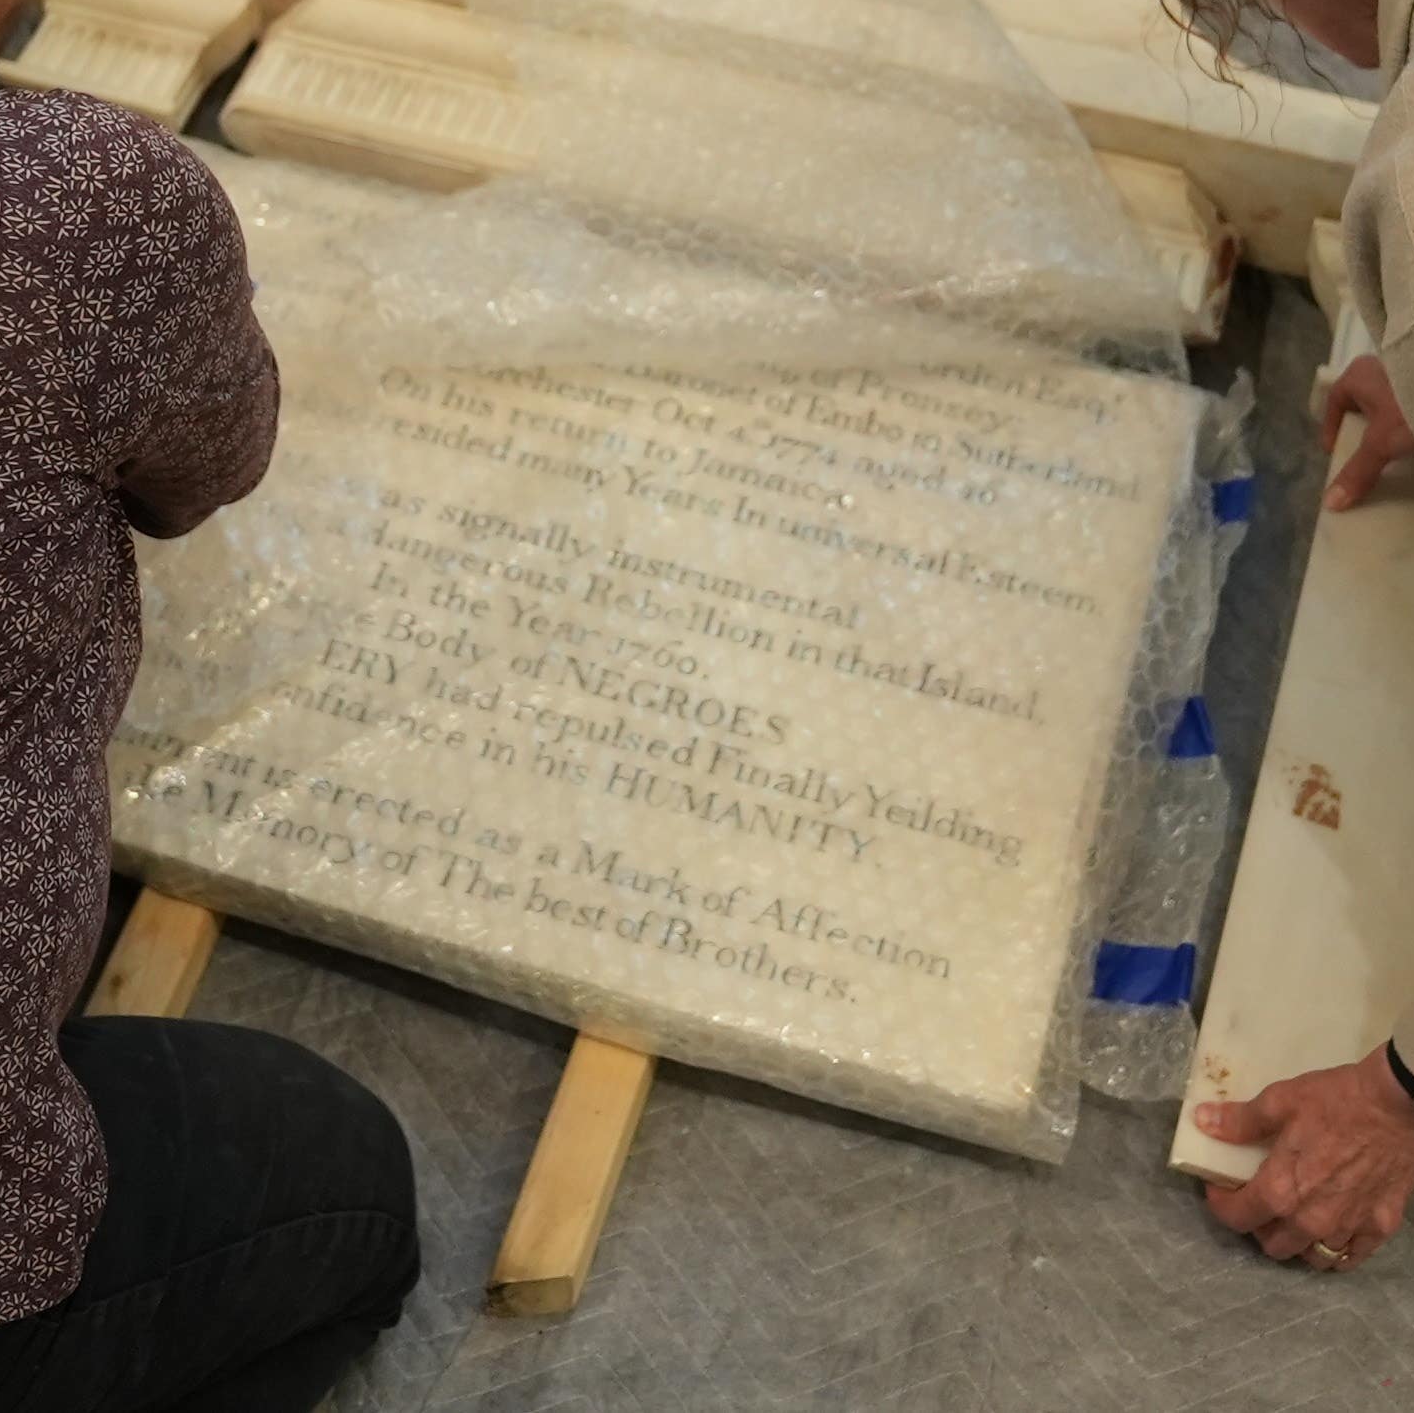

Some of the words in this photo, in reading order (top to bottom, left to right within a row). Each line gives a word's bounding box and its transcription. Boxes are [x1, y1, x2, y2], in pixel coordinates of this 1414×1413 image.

[380, 365, 431, 403] On
[440, 382, 495, 418] his
[508, 408, 635, 457] return
[642, 438, 678, 464] to
[438, 500, 596, 565] signally
[606, 536, 860, 630] instrumental
[515, 450, 617, 493] many
[623, 464, 724, 517] Years
[733, 494, 767, 528] In
[779, 515, 949, 575] universal
[371, 561, 409, 599] In
[430, 580, 491, 620] the
[508, 594, 602, 647] Year
[372, 518, 569, 596] dangerous
[581, 572, 774, 654] Rebellion
[786, 628, 823, 665] in
[834, 643, 910, 688] that
[385, 608, 497, 670] Body
[509, 652, 554, 681] of
[556, 655, 791, 747] NEGROES
[425, 665, 504, 713] had
[511, 701, 700, 767] repulsed
[707, 740, 856, 816] Finally
[865, 782, 1023, 869] Yeilding
[479, 725, 517, 767] in
[533, 740, 591, 787] his
[262, 765, 299, 790] is
[308, 777, 467, 837] erected
[474, 827, 524, 856] as
[537, 845, 560, 869] a
[570, 838, 692, 908] Mark
[700, 884, 753, 920] of
[748, 896, 952, 981] Affection
[382, 845, 432, 876] of
[436, 848, 517, 903] The
[523, 875, 608, 932] best
[614, 909, 656, 945] of
[655, 915, 859, 1004] Brothers.
